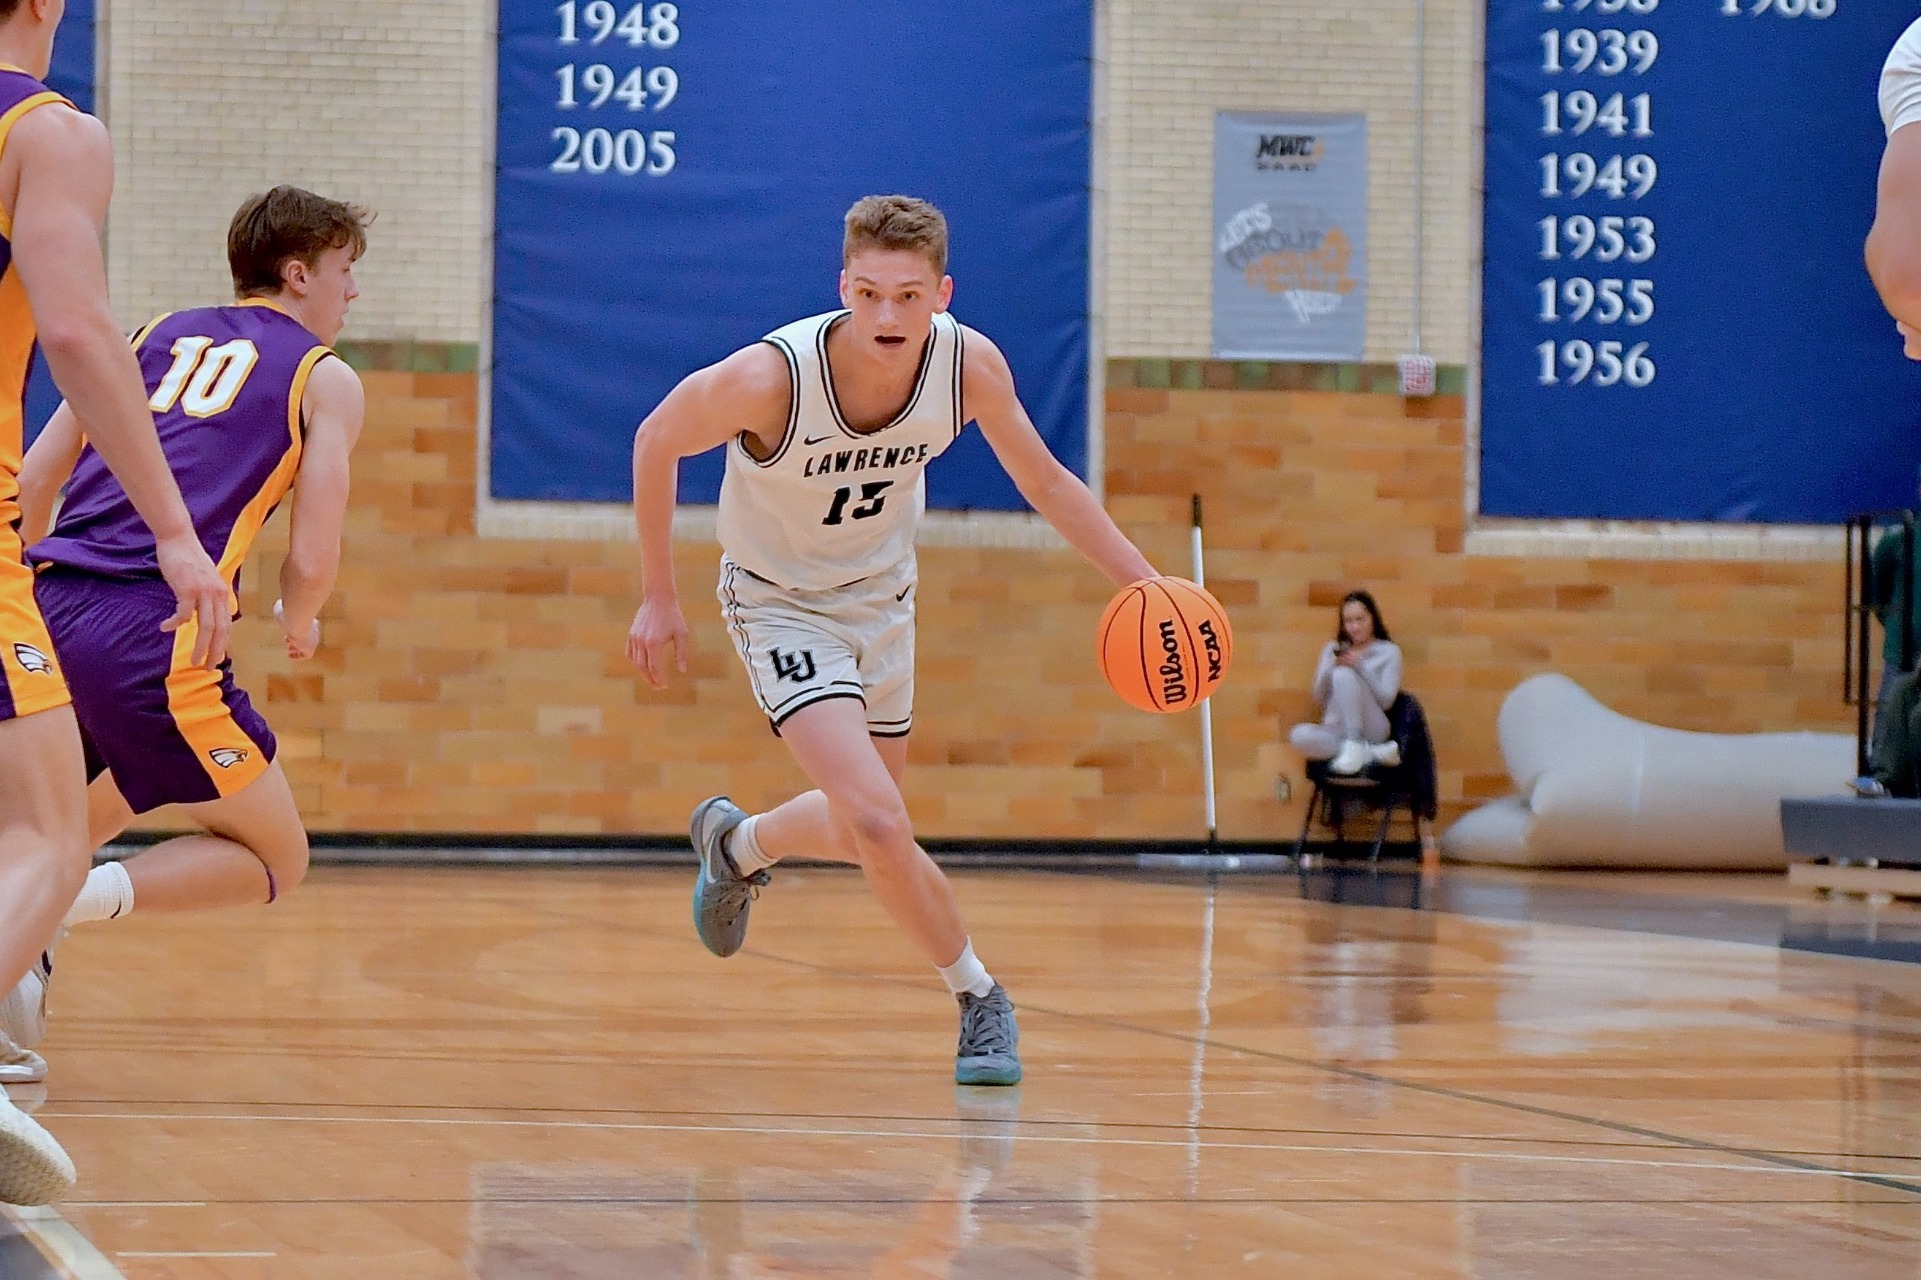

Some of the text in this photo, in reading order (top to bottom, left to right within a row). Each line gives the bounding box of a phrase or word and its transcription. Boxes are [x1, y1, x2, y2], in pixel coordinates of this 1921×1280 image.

[557, 0, 680, 49] 1948
[1539, 28, 1659, 77] 1939
[555, 63, 679, 110] 1949
[1539, 89, 1655, 138] 1941
[551, 127, 676, 176] 2005
[1539, 152, 1658, 200] 1949
[1537, 214, 1657, 263] 1953
[1537, 277, 1655, 326] 1955
[149, 335, 260, 418] 10
[1537, 339, 1657, 387] 1956
[803, 443, 929, 478] LAWRENCE
[821, 480, 895, 526] 15
[1158, 619, 1188, 705] Wilson
[1197, 619, 1222, 682] NCAA
